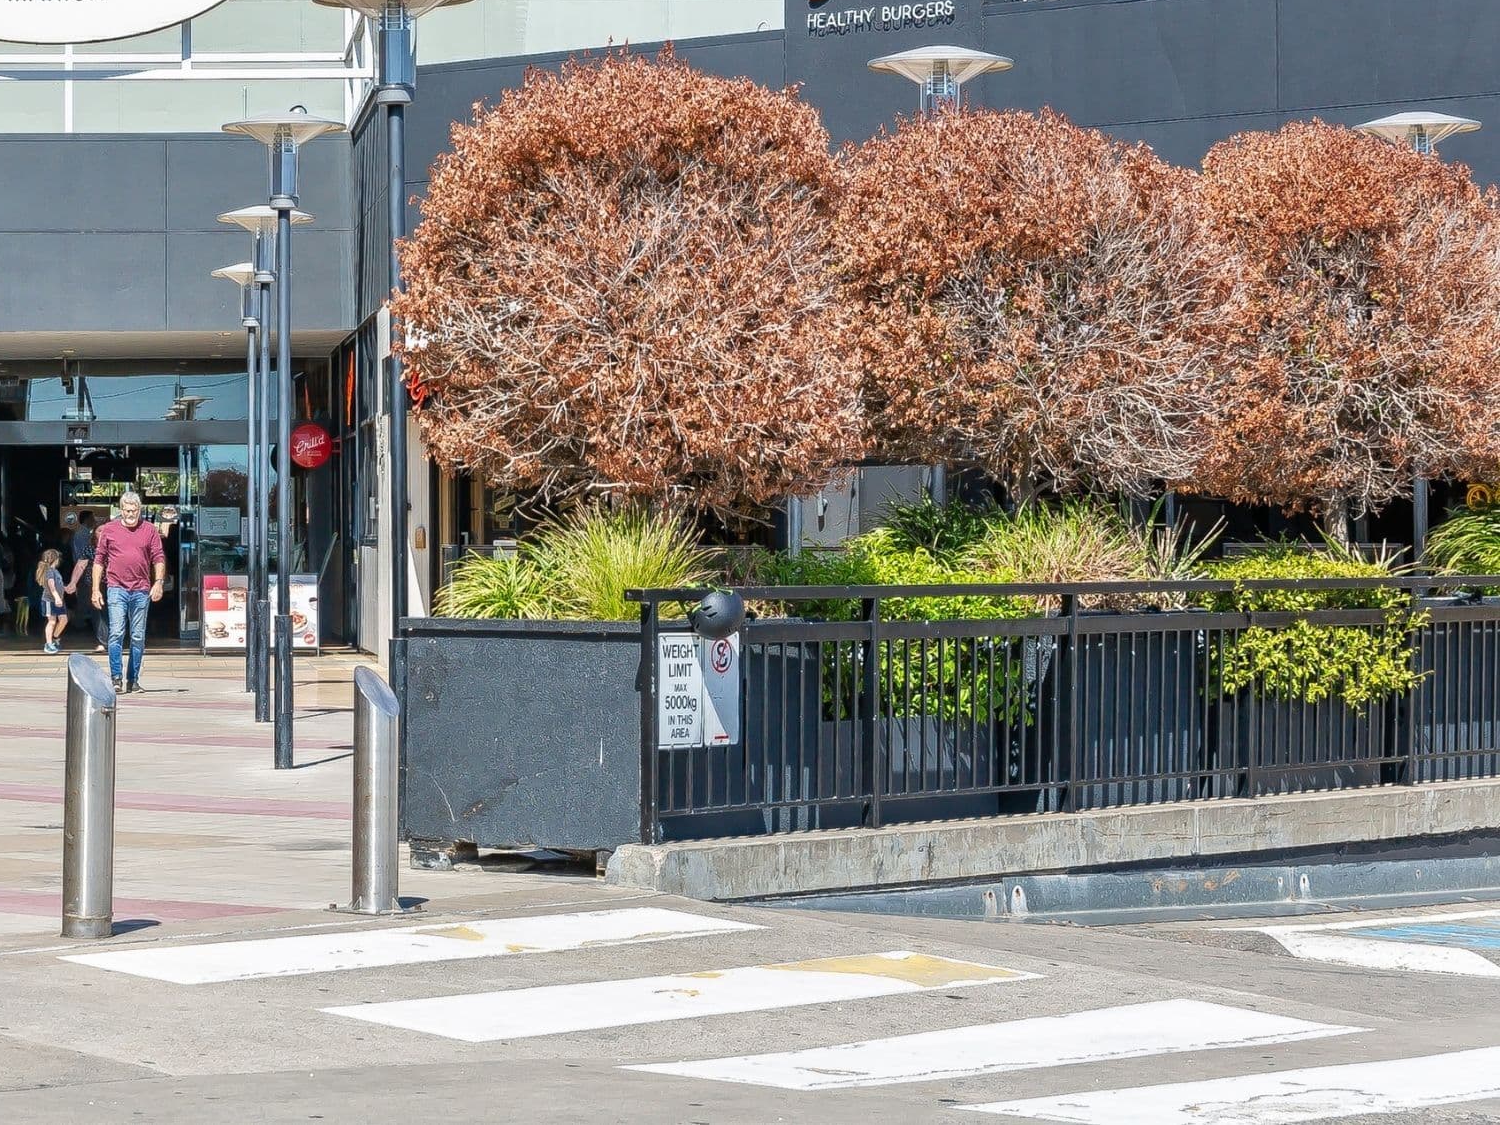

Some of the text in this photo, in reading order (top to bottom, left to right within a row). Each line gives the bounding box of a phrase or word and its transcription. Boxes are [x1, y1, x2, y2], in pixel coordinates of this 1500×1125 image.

[807, 0, 955, 29] HEALTHY BURGERS
[662, 644, 699, 658] WEIGHT
[668, 663, 692, 677] LIMIT
[674, 683, 687, 692] MAX
[665, 695, 697, 711] 5000kg
[668, 714, 693, 725] IN THIS
[671, 728, 689, 739] AREA
